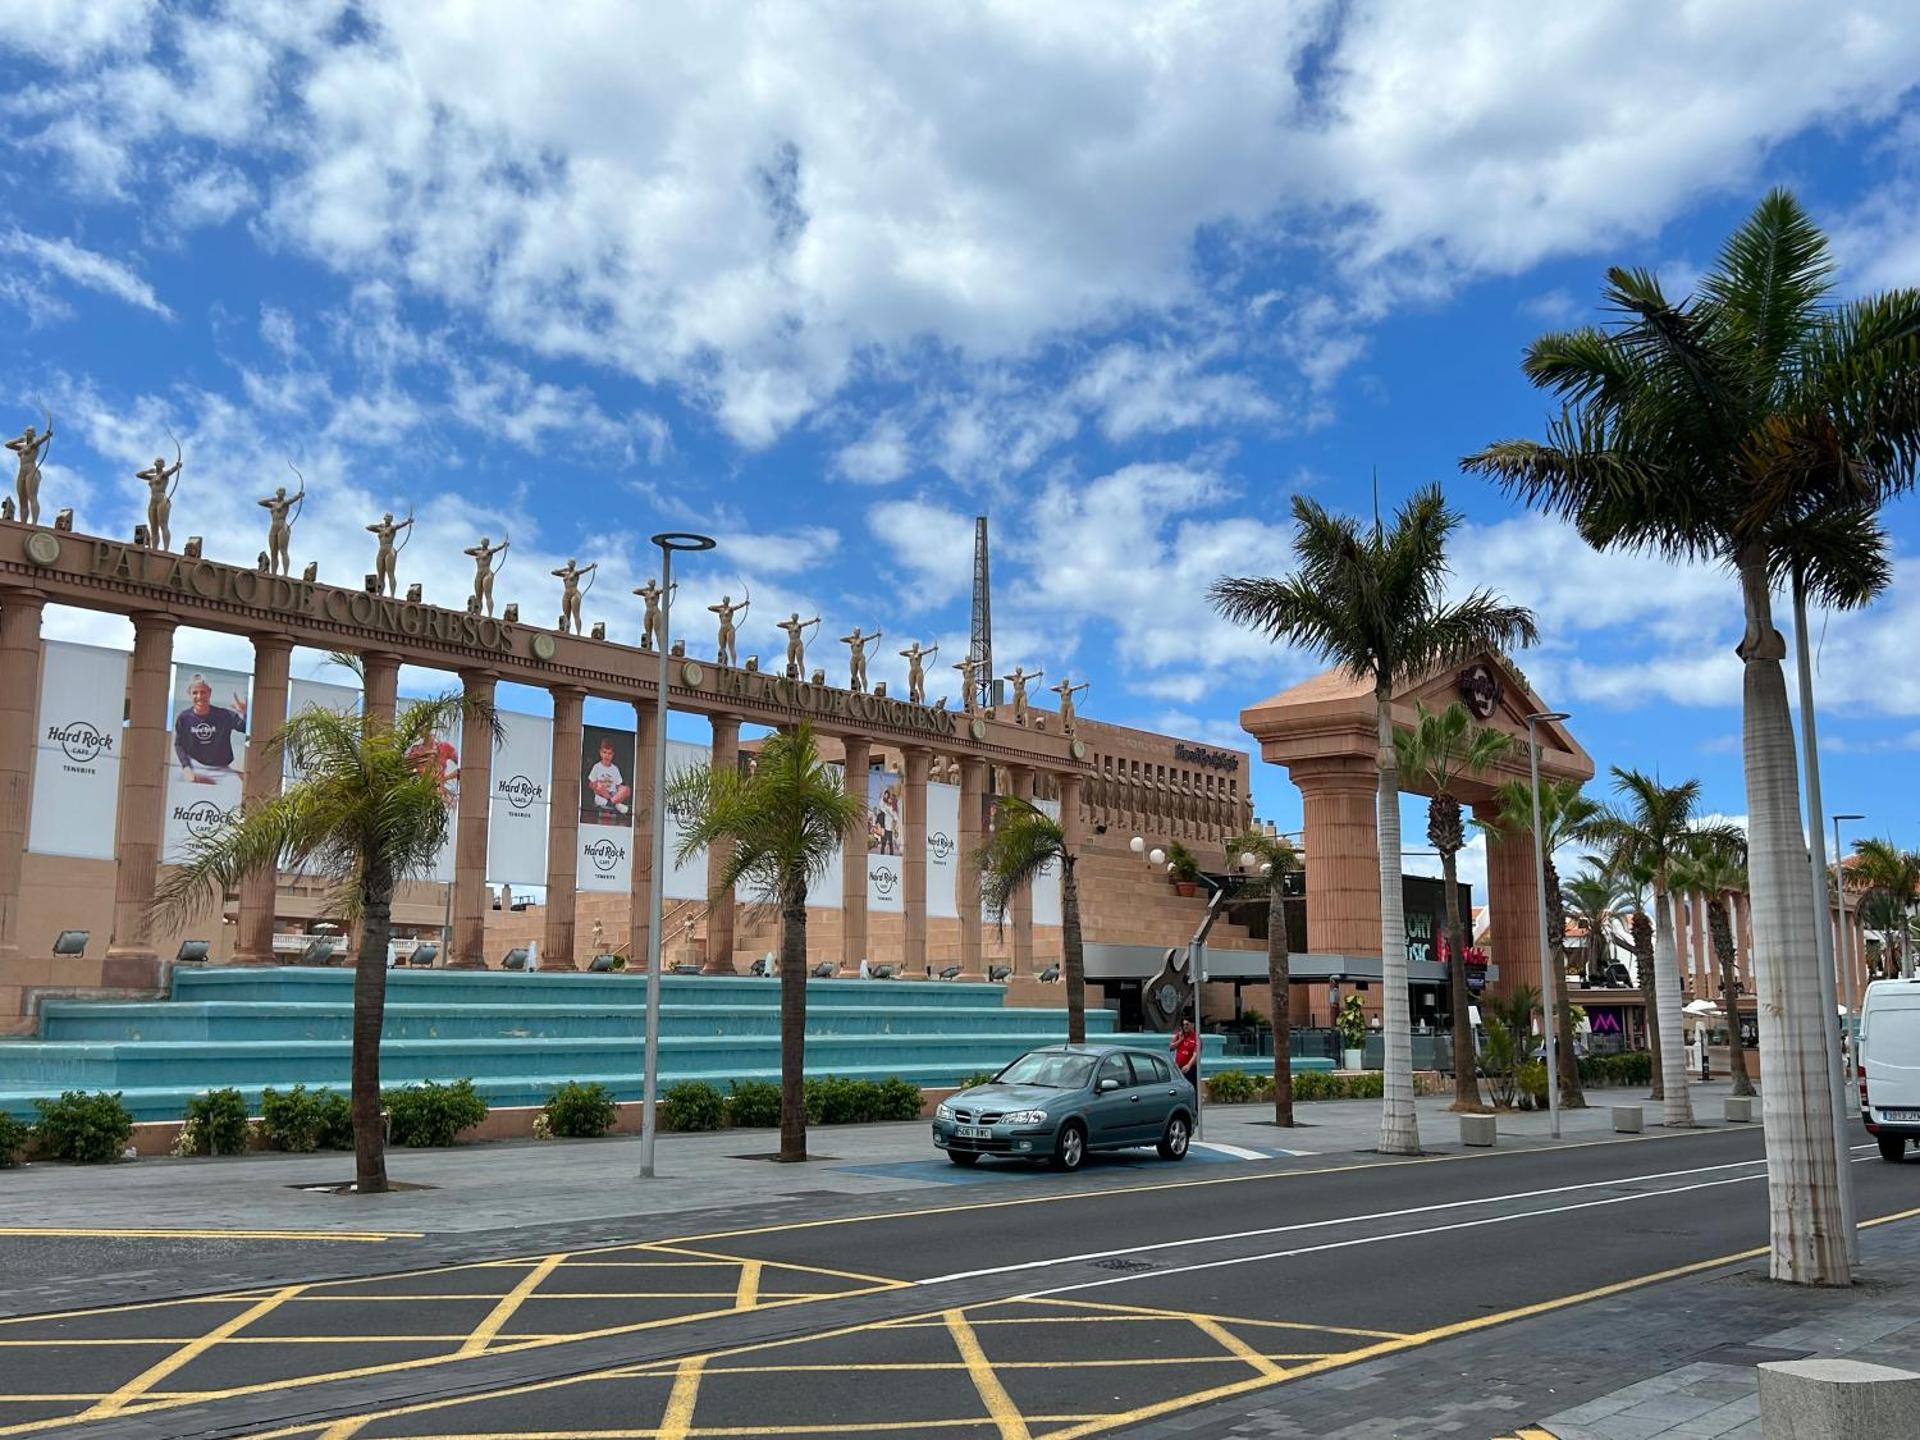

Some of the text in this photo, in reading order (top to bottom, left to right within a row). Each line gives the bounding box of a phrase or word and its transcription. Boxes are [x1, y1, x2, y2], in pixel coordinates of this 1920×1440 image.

[92, 540, 515, 652] PALACIO DE CONGRESOS
[717, 666, 957, 734] PALACIO DE CONGRESOS
[47, 726, 113, 750] Hard Rock
[63, 765, 96, 775] TENERIFE
[498, 780, 542, 798] Hard Rock
[173, 806, 205, 822] Hard
[583, 844, 625, 860] Hard Rock
